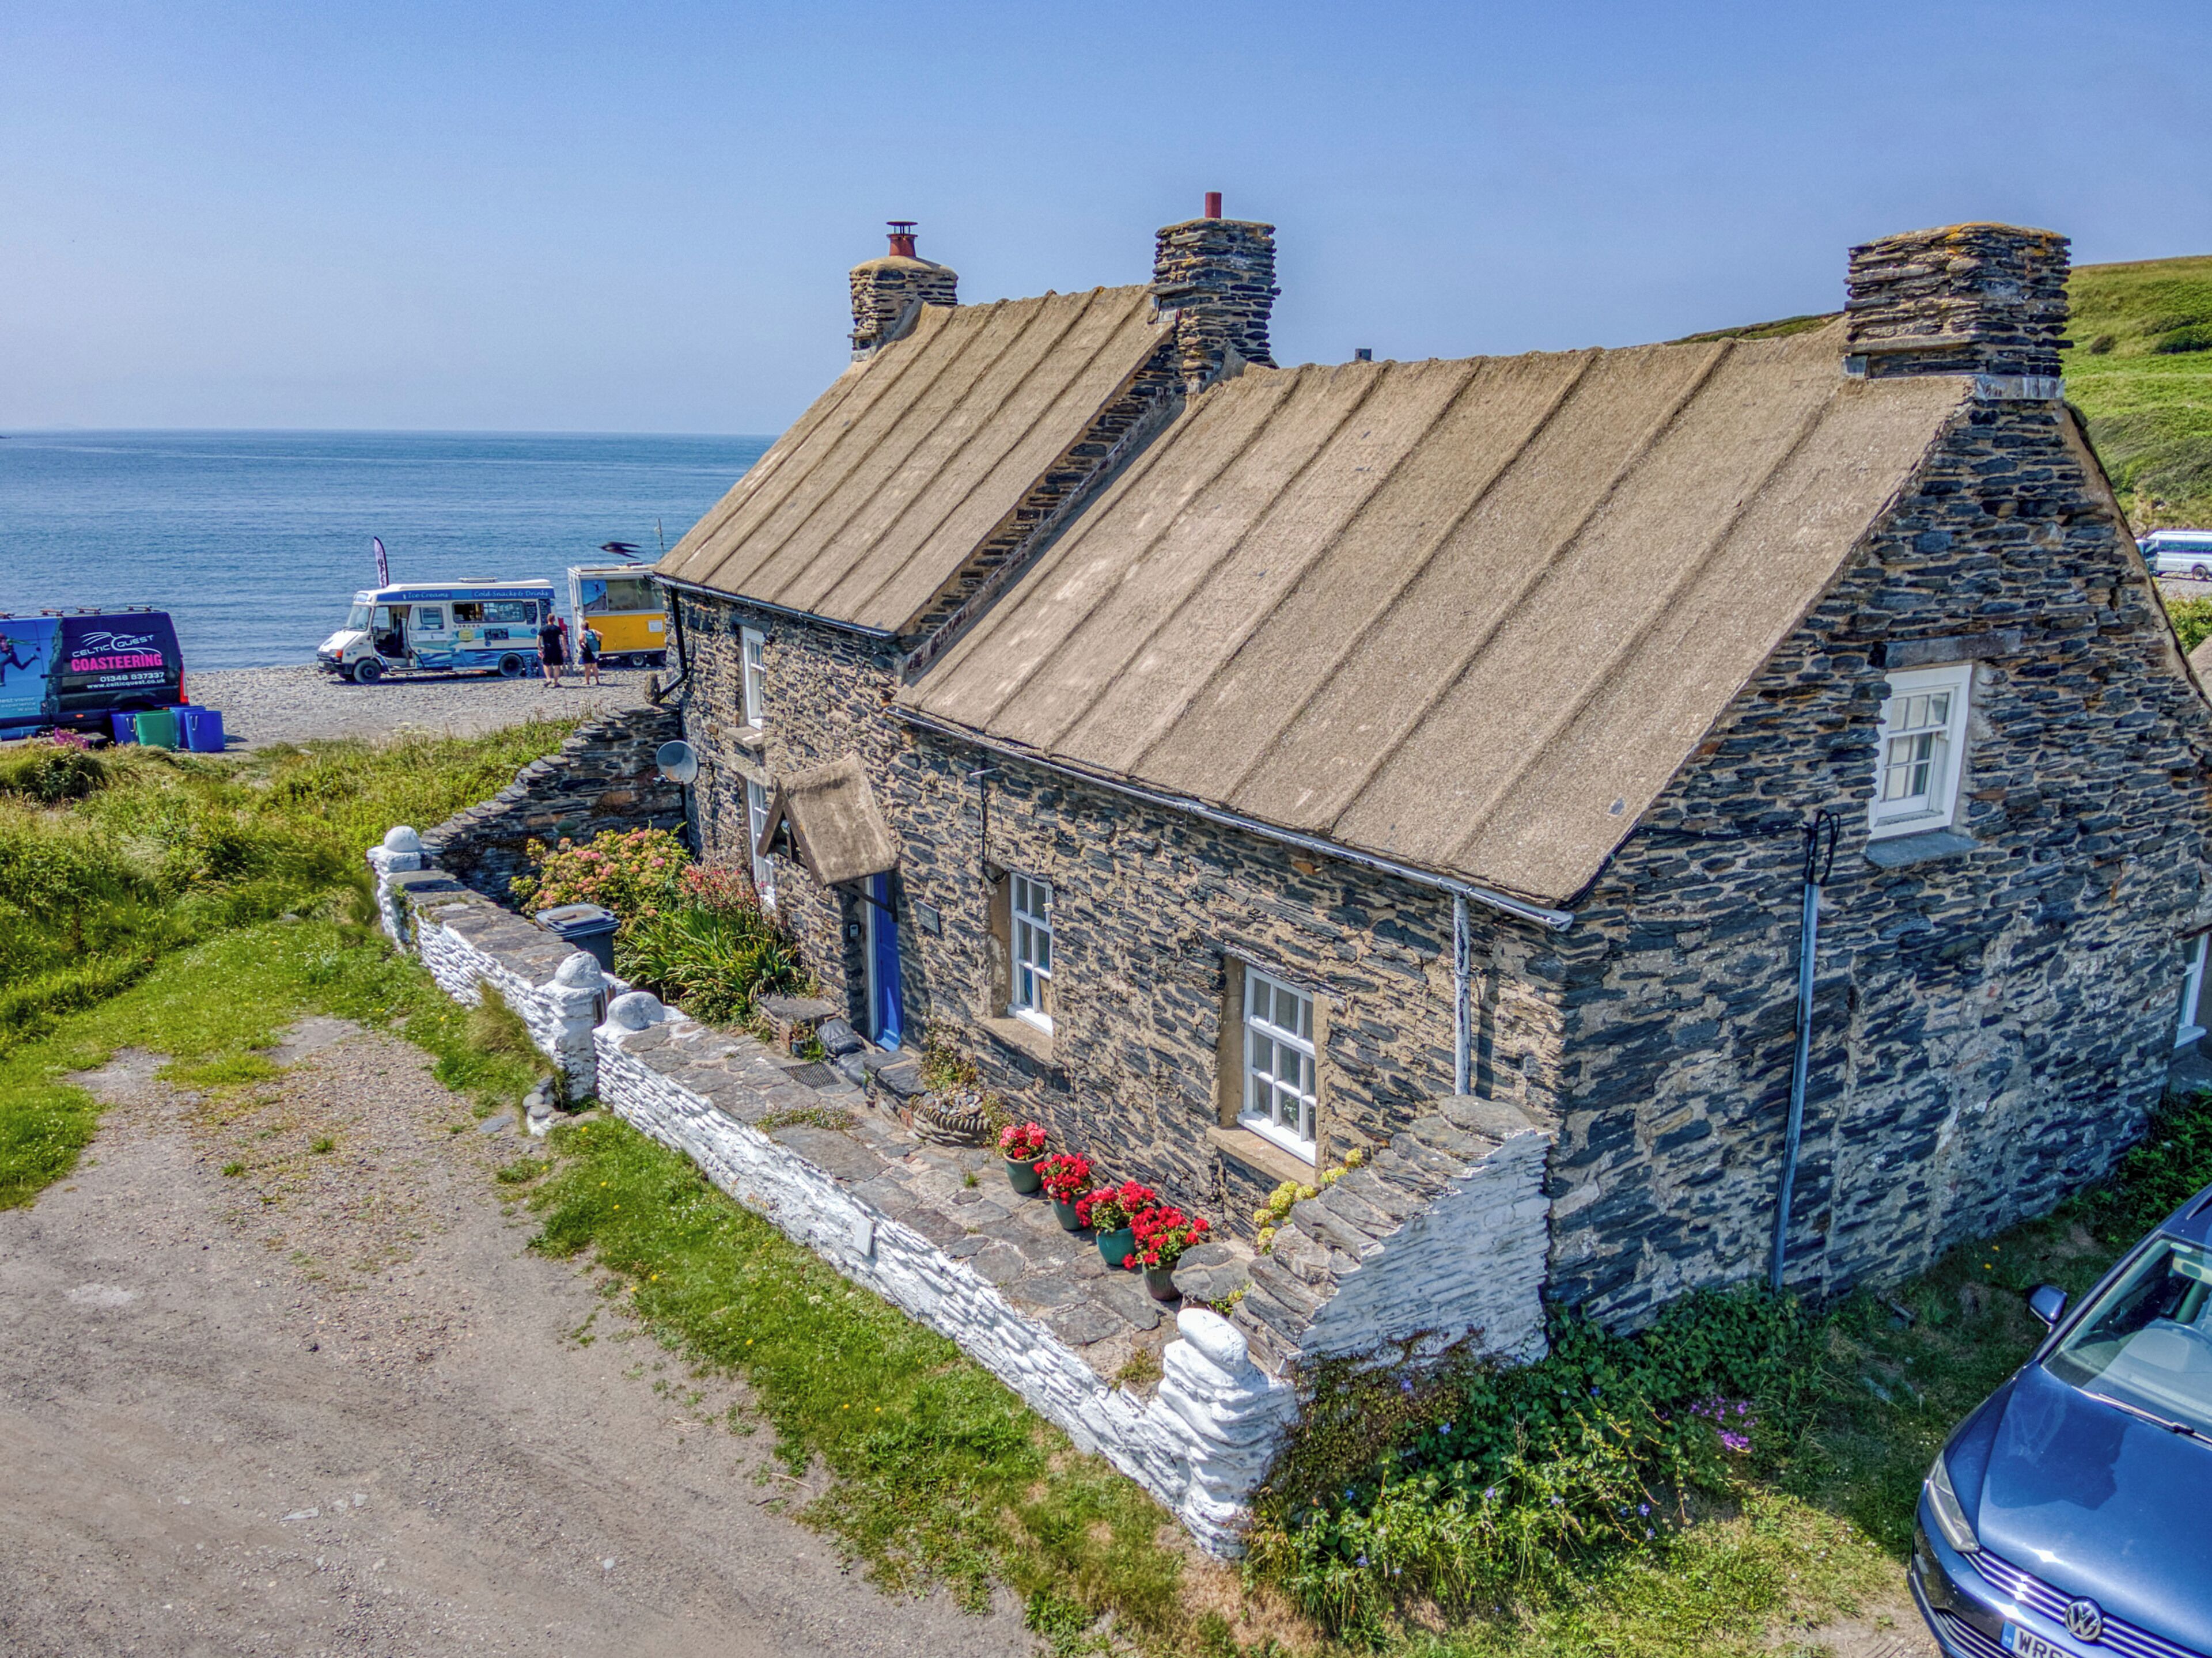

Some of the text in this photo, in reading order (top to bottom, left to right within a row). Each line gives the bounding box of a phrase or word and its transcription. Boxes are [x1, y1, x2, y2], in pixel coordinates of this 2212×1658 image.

[72, 635, 154, 658] CELTIC QUEST
[71, 654, 162, 671] COASTEERING
[86, 678, 166, 689] www.celticquest.co.uk
[100, 672, 165, 682] 01348 837337
[2018, 1631, 2073, 1658] WR
